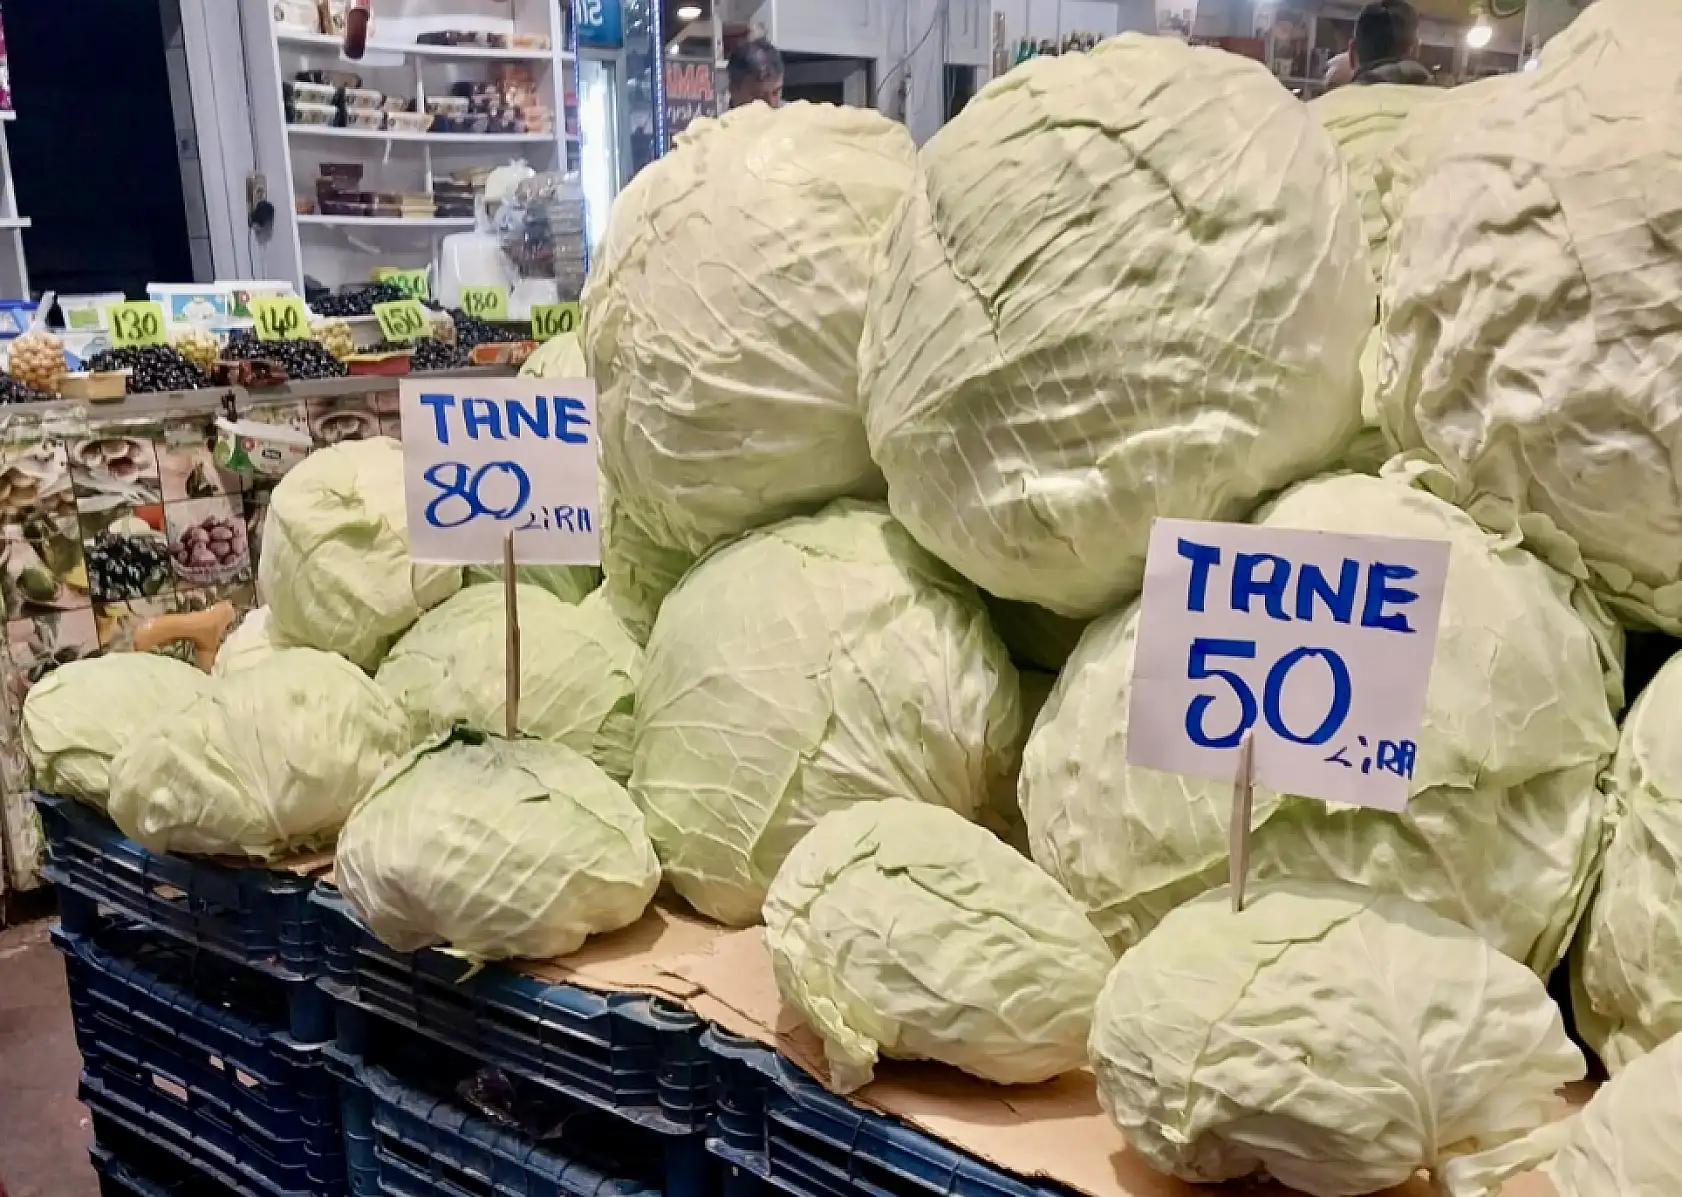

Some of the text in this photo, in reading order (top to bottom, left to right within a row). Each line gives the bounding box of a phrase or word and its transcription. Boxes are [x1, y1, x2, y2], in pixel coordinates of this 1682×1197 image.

[464, 289, 498, 314] 180
[113, 308, 158, 340] 130
[260, 304, 298, 337] 140
[382, 306, 423, 336] 150
[535, 307, 573, 334] 160
[419, 393, 591, 445] TANE
[423, 461, 531, 528] 80
[1177, 536, 1420, 634] TANE
[1184, 637, 1352, 749] 50
